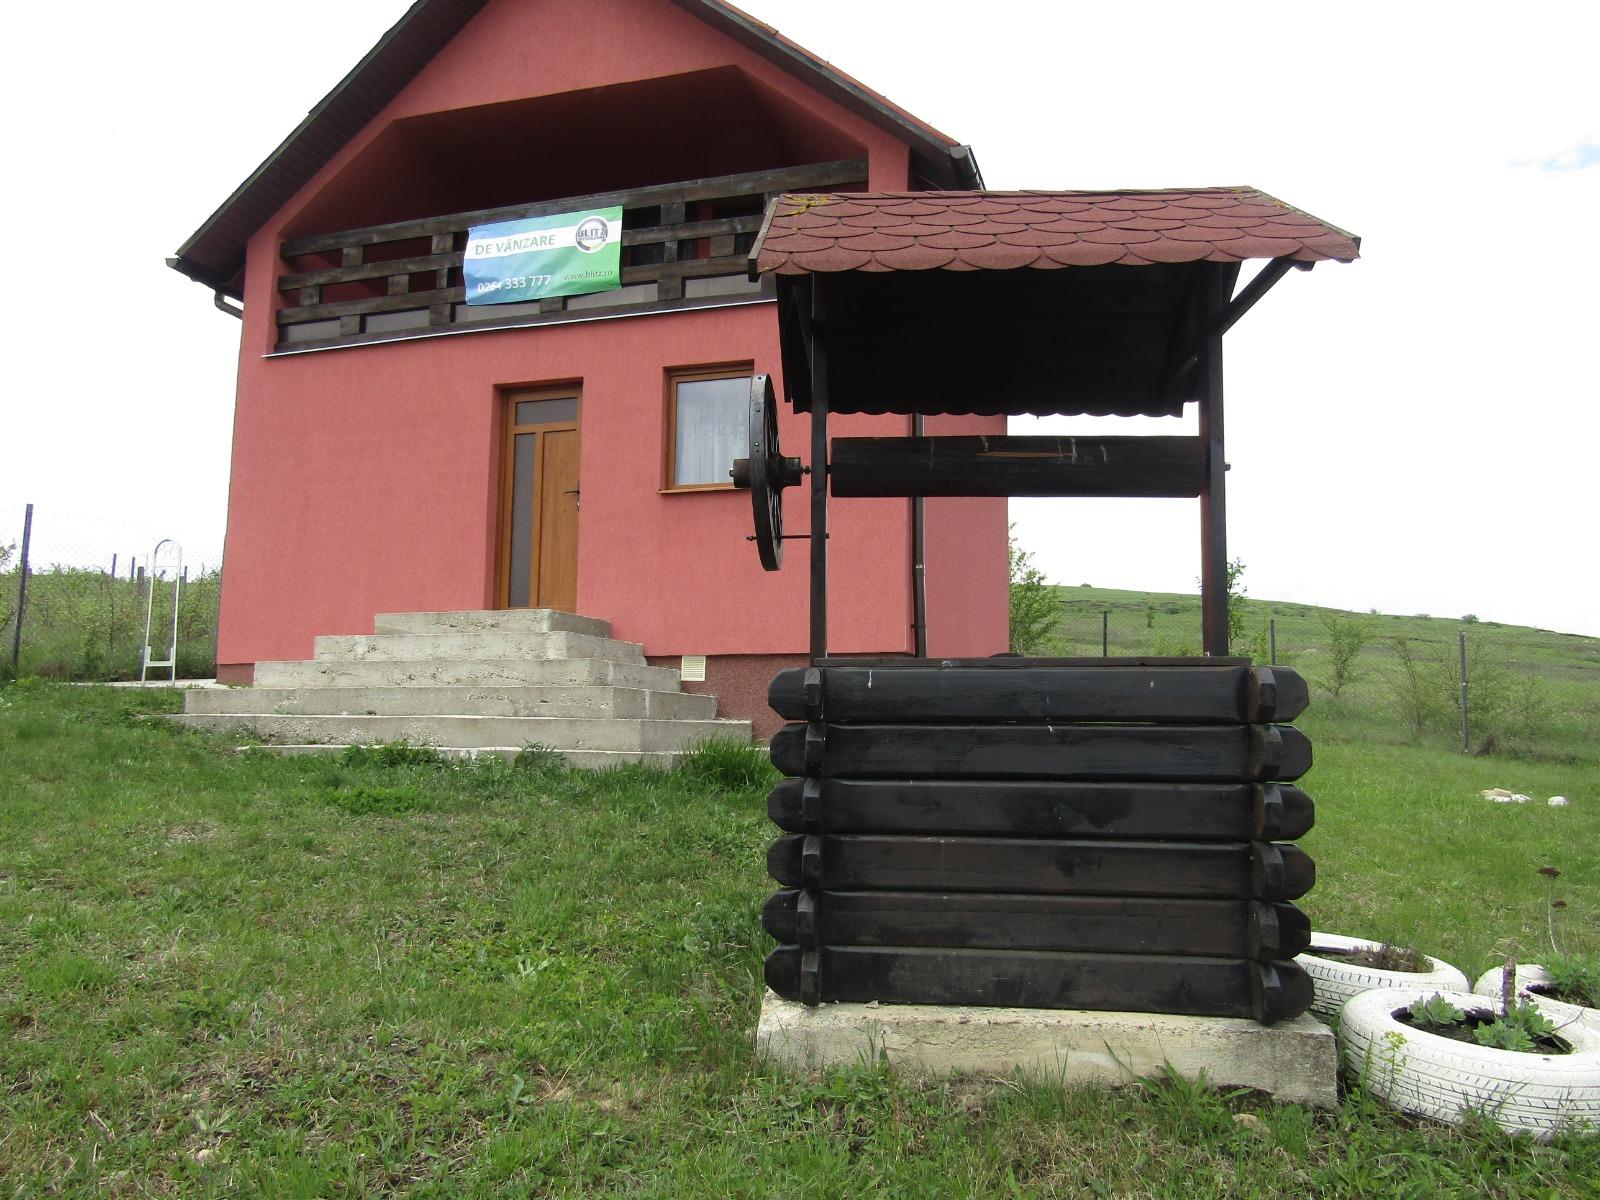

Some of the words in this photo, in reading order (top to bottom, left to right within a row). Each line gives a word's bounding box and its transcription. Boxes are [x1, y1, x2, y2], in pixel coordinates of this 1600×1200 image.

[577, 228, 607, 238] BLITZ
[475, 243, 492, 256] DE
[496, 234, 556, 253] VÂNZARE
[505, 276, 526, 290] 333
[528, 274, 552, 287] 777
[563, 270, 613, 281] www.blitz.ro
